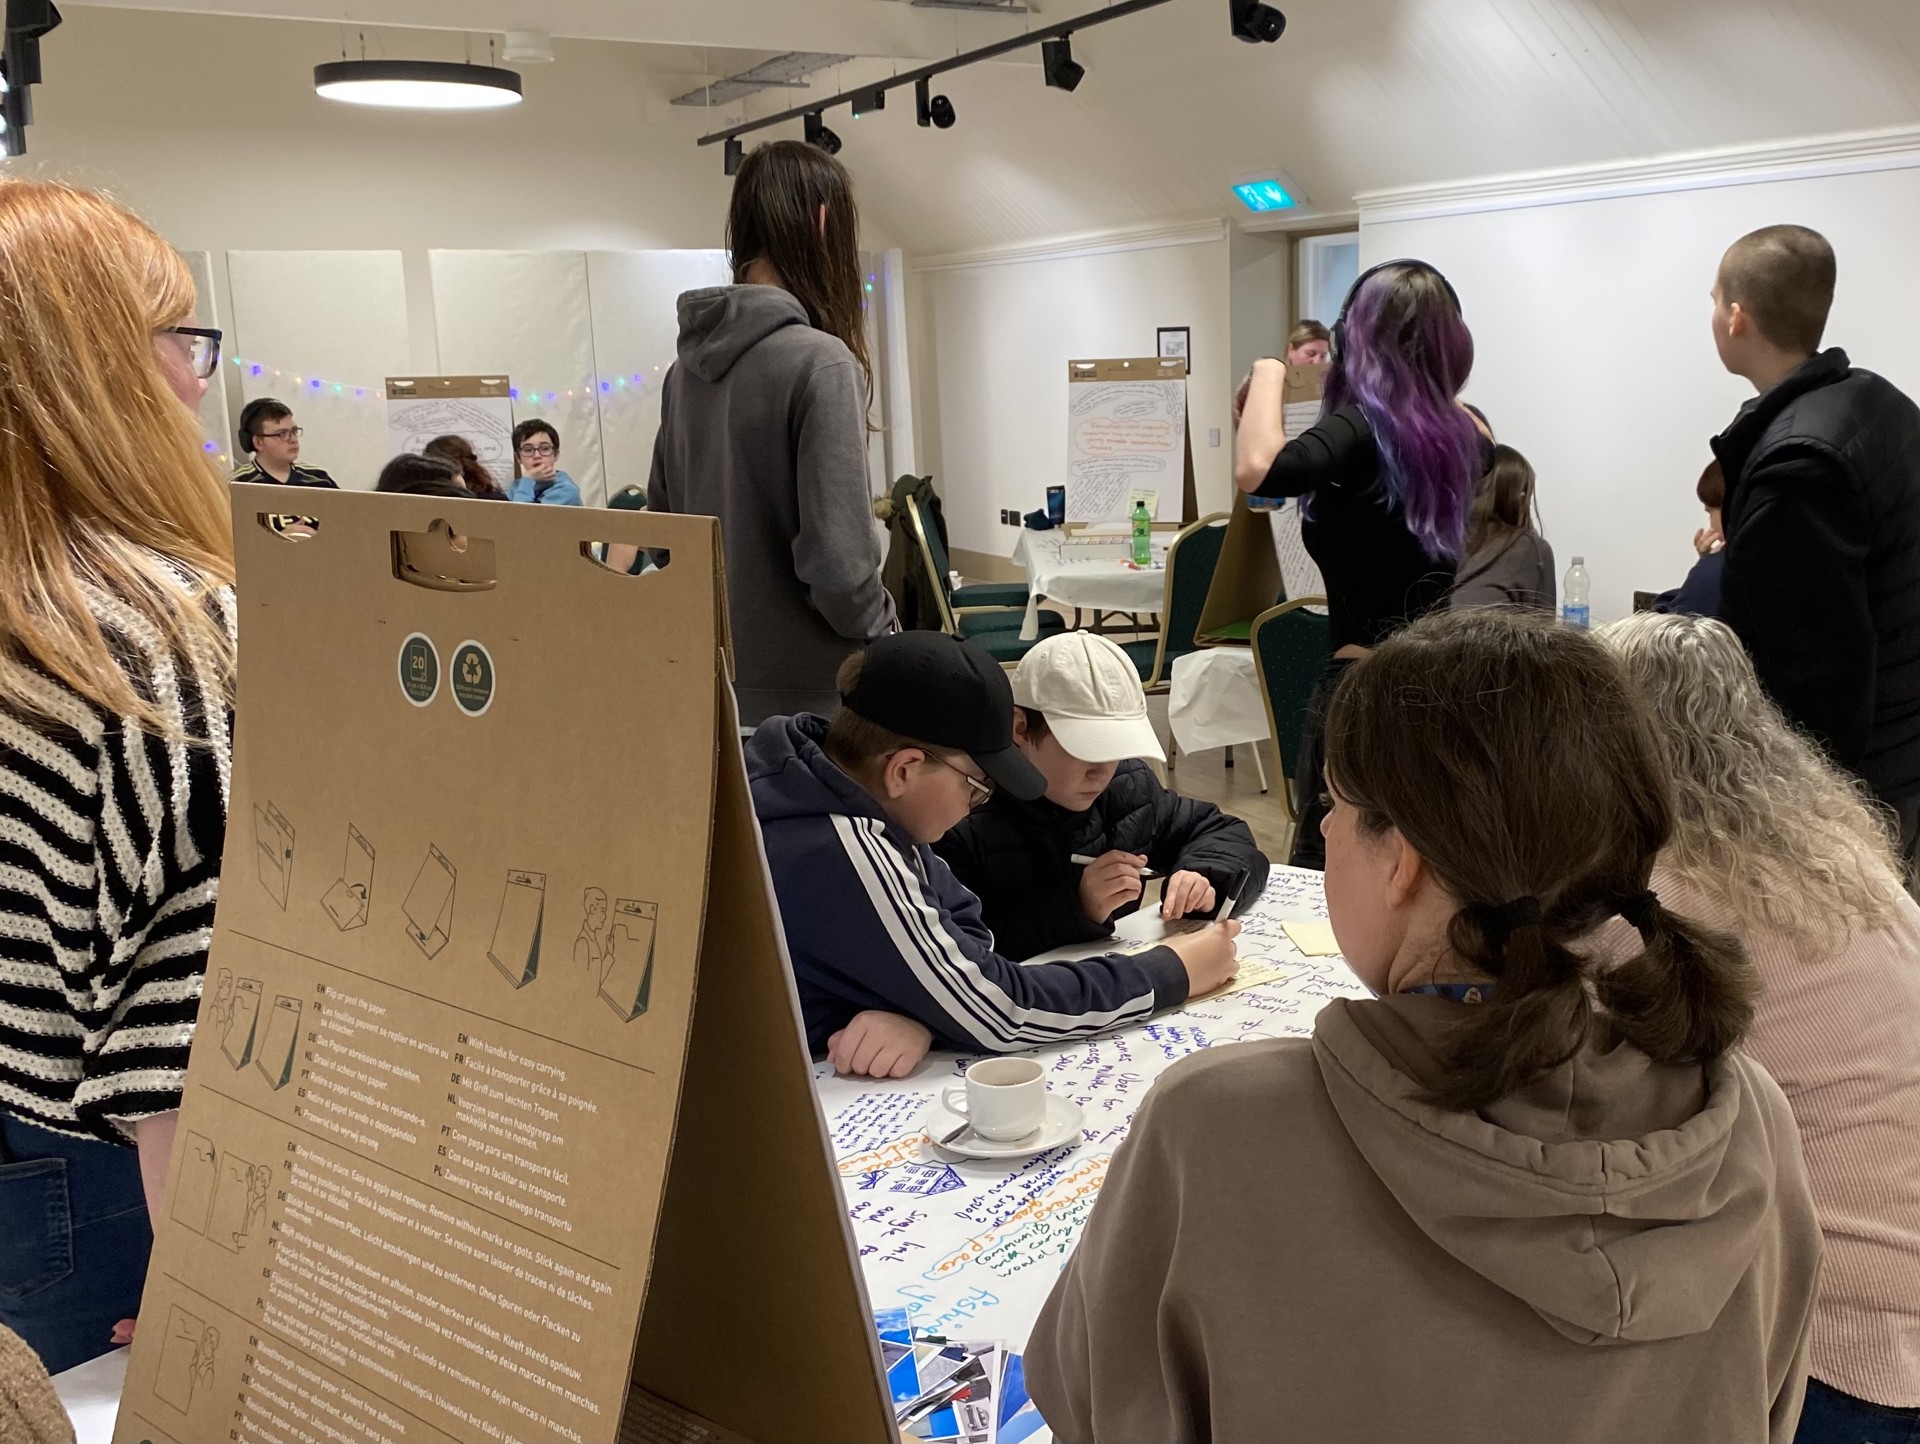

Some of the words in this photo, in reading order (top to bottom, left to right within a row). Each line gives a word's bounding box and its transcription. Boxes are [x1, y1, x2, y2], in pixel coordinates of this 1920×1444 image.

[412, 655, 425, 670] 20
[316, 983, 325, 994] EN
[457, 1032, 467, 1045] EN
[468, 1036, 483, 1050] With
[484, 1042, 506, 1059] handle
[508, 1050, 517, 1062] for
[519, 1057, 534, 1071] easy
[450, 1072, 460, 1084] DE
[461, 1076, 472, 1089] Mit
[473, 1080, 488, 1095] Griff
[489, 1089, 503, 1101] zum
[504, 1092, 532, 1111] leichten
[453, 1052, 464, 1064] FR
[464, 1056, 484, 1072] Facile
[486, 1064, 490, 1074] à
[491, 1066, 529, 1088] transporter
[530, 1083, 550, 1096] grâce
[552, 1088, 557, 1098] à
[558, 1093, 566, 1102] sa
[446, 1092, 456, 1104] NL
[457, 1096, 486, 1116] Voorzien
[487, 1110, 498, 1121] van
[500, 1115, 513, 1126] een
[513, 1117, 550, 1143] handgreep
[551, 1135, 563, 1146] om
[455, 1112, 487, 1131] makkelijk
[488, 1125, 503, 1136] mee
[504, 1129, 511, 1140] te
[283, 1159, 292, 1171] FR
[437, 1144, 446, 1156] ES
[448, 1149, 461, 1163] Con
[462, 1157, 473, 1168] asa
[474, 1162, 490, 1175] para
[491, 1167, 516, 1186] facilitar
[518, 1181, 527, 1190] su
[440, 1124, 450, 1137] PT
[451, 1129, 467, 1144] Com
[467, 1138, 484, 1151] pega
[484, 1145, 500, 1157] para
[502, 1152, 513, 1163] um
[514, 1154, 550, 1178] transporte
[287, 1140, 296, 1153] EN
[296, 1144, 308, 1160] Stay
[309, 1150, 325, 1168] firmly
[326, 1158, 332, 1169] in
[351, 1169, 365, 1186] Easy
[365, 1176, 372, 1187] to
[373, 1182, 389, 1197] apply
[390, 1189, 402, 1201] and
[428, 1204, 454, 1225] Remove
[455, 1218, 480, 1236] without
[481, 1230, 503, 1247] marks
[504, 1240, 511, 1250] or
[535, 1251, 553, 1269] Stick
[554, 1263, 574, 1279] again
[575, 1273, 590, 1286] and
[433, 1164, 442, 1176] PL
[444, 1169, 470, 1188] Zawiera
[494, 1190, 504, 1203] dla
[534, 1207, 572, 1232] transportu
[362, 1229, 382, 1247] Leicht
[382, 1242, 420, 1266] anzubringen
[421, 1260, 434, 1273] und
[434, 1267, 443, 1277] zu
[478, 1285, 496, 1303] Ohne
[497, 1294, 522, 1316] Spuren
[523, 1308, 539, 1324] oder
[541, 1315, 570, 1339] Flecken
[571, 1332, 580, 1344] zu
[424, 1316, 440, 1333] Uma
[441, 1327, 452, 1339] vez
[453, 1333, 484, 1355] removido
[485, 1349, 497, 1363] não
[498, 1354, 517, 1373] deixa
[518, 1367, 545, 1387] marcas
[546, 1381, 563, 1396] nem
